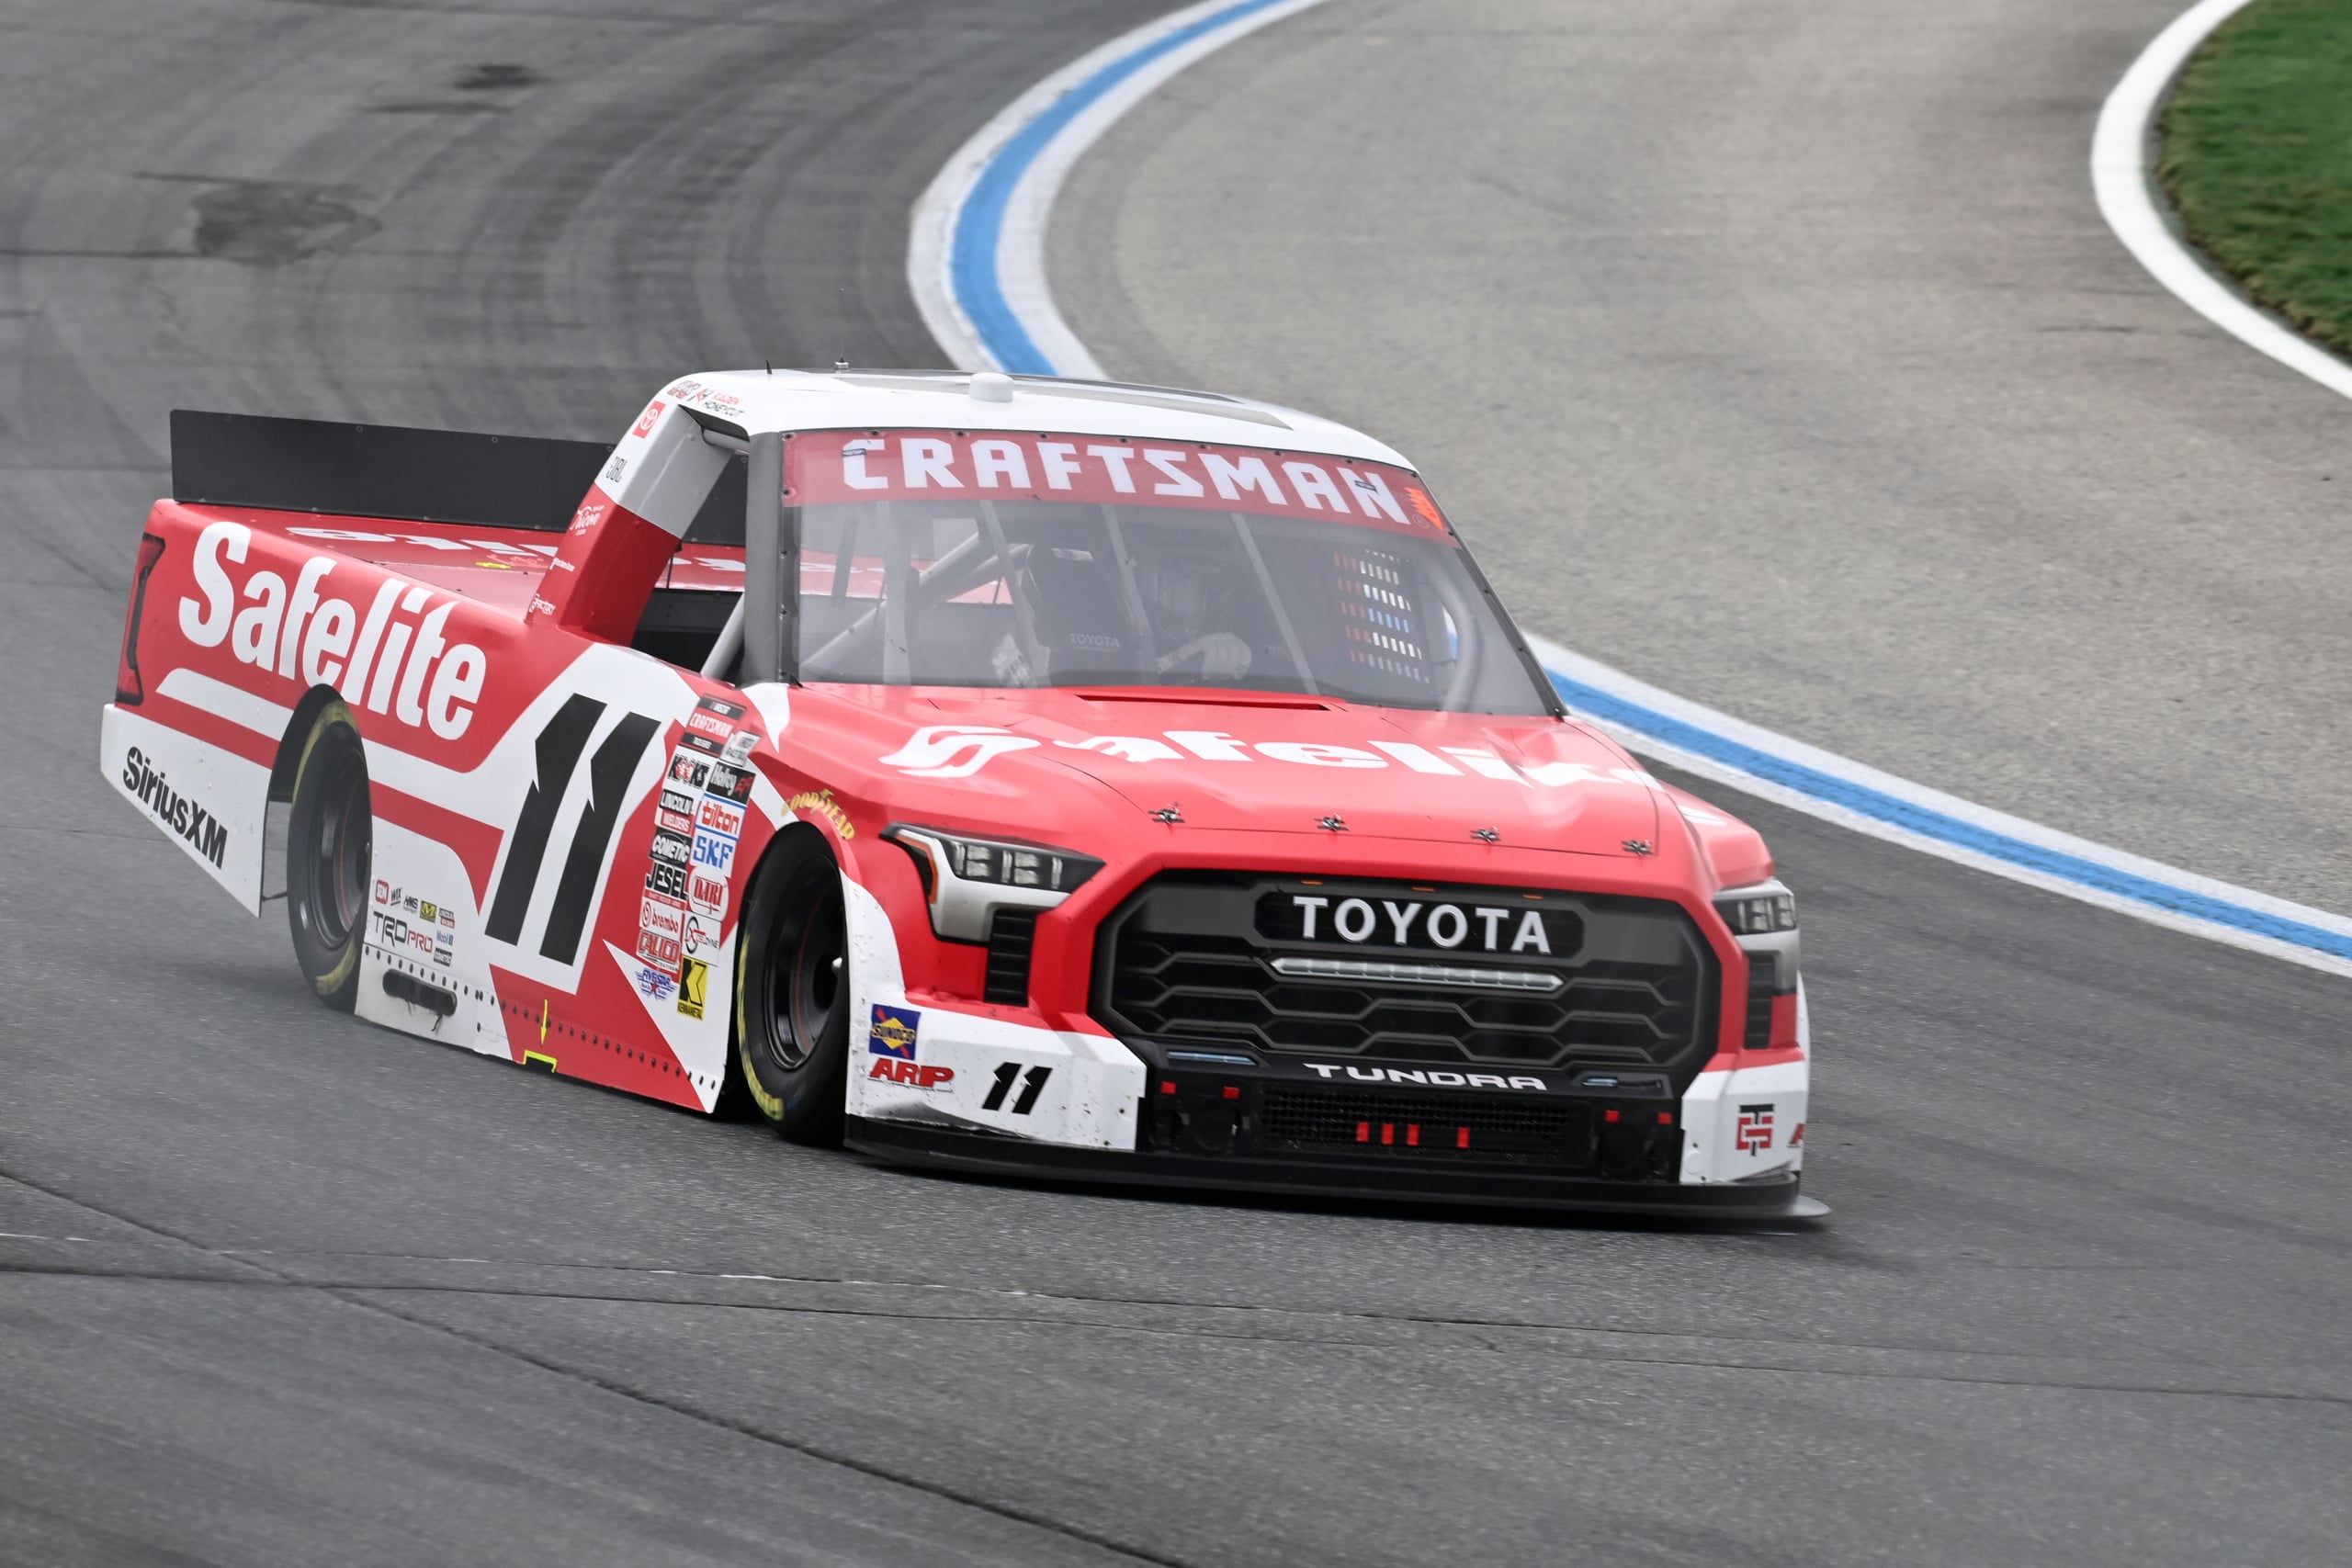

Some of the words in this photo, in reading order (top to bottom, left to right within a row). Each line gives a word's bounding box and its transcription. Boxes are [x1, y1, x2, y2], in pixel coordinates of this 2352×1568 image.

[842, 437, 1411, 525] CRAFTSMAN
[178, 522, 487, 741] Safelite
[689, 713, 734, 739] CRAFTSMAN
[709, 762, 738, 796] Holley
[122, 746, 228, 870] SiriusXM
[660, 791, 694, 815] LINCOLN
[703, 801, 740, 835] tilton
[780, 791, 855, 840] GOODYEAR
[484, 693, 662, 966] 11
[651, 835, 690, 863] COMETIC
[693, 835, 733, 869] SKF
[646, 862, 688, 900] JESEL
[374, 911, 407, 947] TRD
[407, 930, 433, 953] PRO
[652, 908, 678, 933] brembo
[1293, 896, 1552, 955] TOYOTA
[639, 931, 680, 964] CALICO
[869, 1057, 955, 1088] ARP
[981, 1062, 1054, 1114] 11
[1303, 1063, 1548, 1091] TUNDRA
